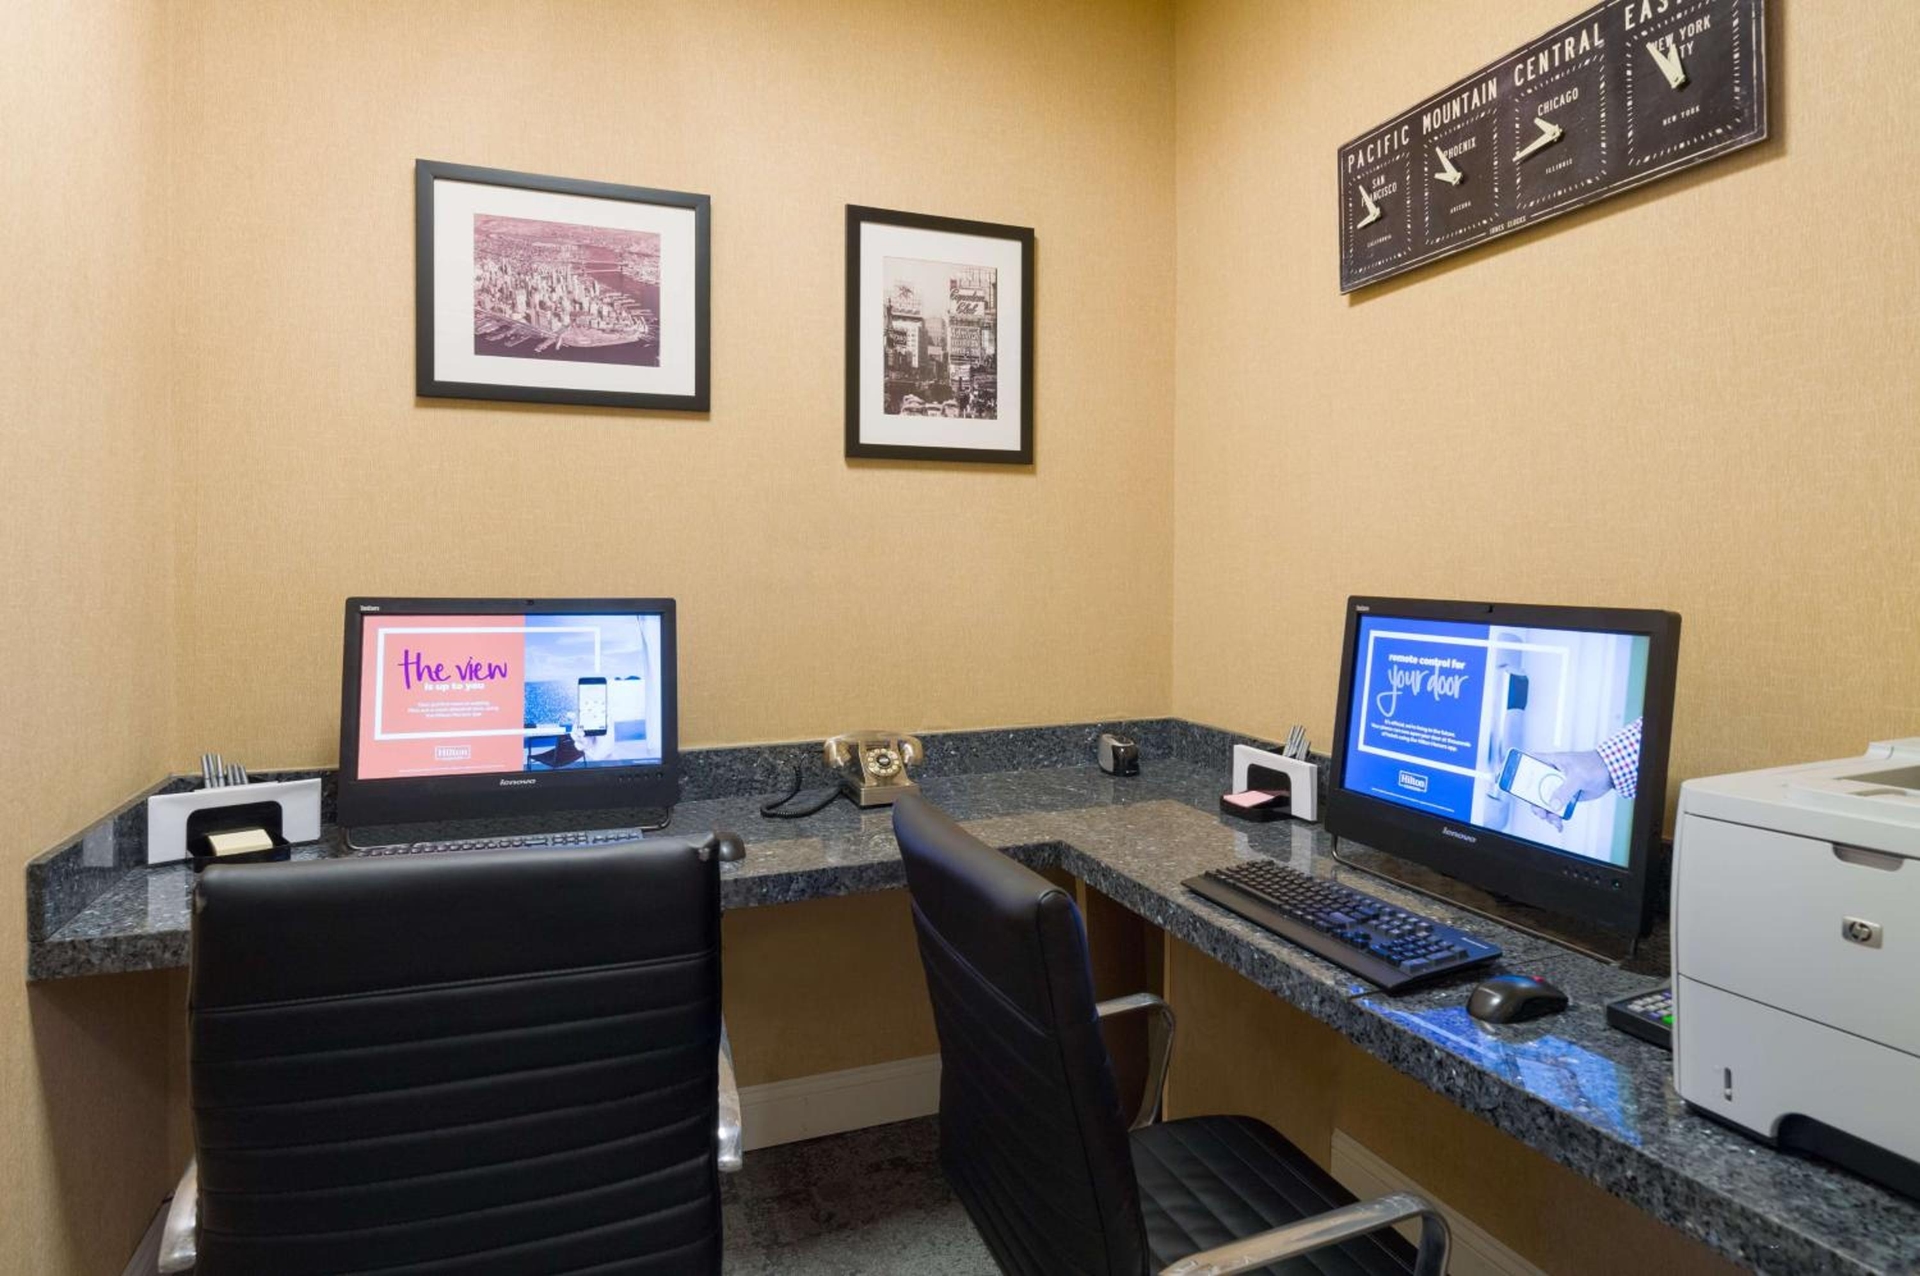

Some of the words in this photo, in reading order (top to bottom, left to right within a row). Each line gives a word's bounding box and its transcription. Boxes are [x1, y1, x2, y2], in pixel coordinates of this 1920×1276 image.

[1625, 0, 1681, 31] EAS
[1679, 14, 1711, 41] YORK
[1514, 22, 1605, 86] CENTRAL
[1423, 77, 1498, 136] MOUNTAIN
[1537, 87, 1579, 117] CHICAGO
[1681, 104, 1700, 118] YORK
[1348, 125, 1410, 173] PACIFIC
[1372, 174, 1386, 189] SAN
[397, 649, 452, 690] the
[455, 656, 508, 681] view
[1388, 654, 1418, 664] remote
[1419, 657, 1451, 668] control
[1451, 659, 1466, 669] for
[436, 683, 449, 692] up
[451, 682, 463, 691] to
[465, 682, 485, 692] you
[1376, 664, 1430, 717] your
[1426, 661, 1469, 701] door
[499, 778, 537, 787] lenovo
[1401, 773, 1426, 787] Hilton
[1442, 826, 1477, 843] lenovo
